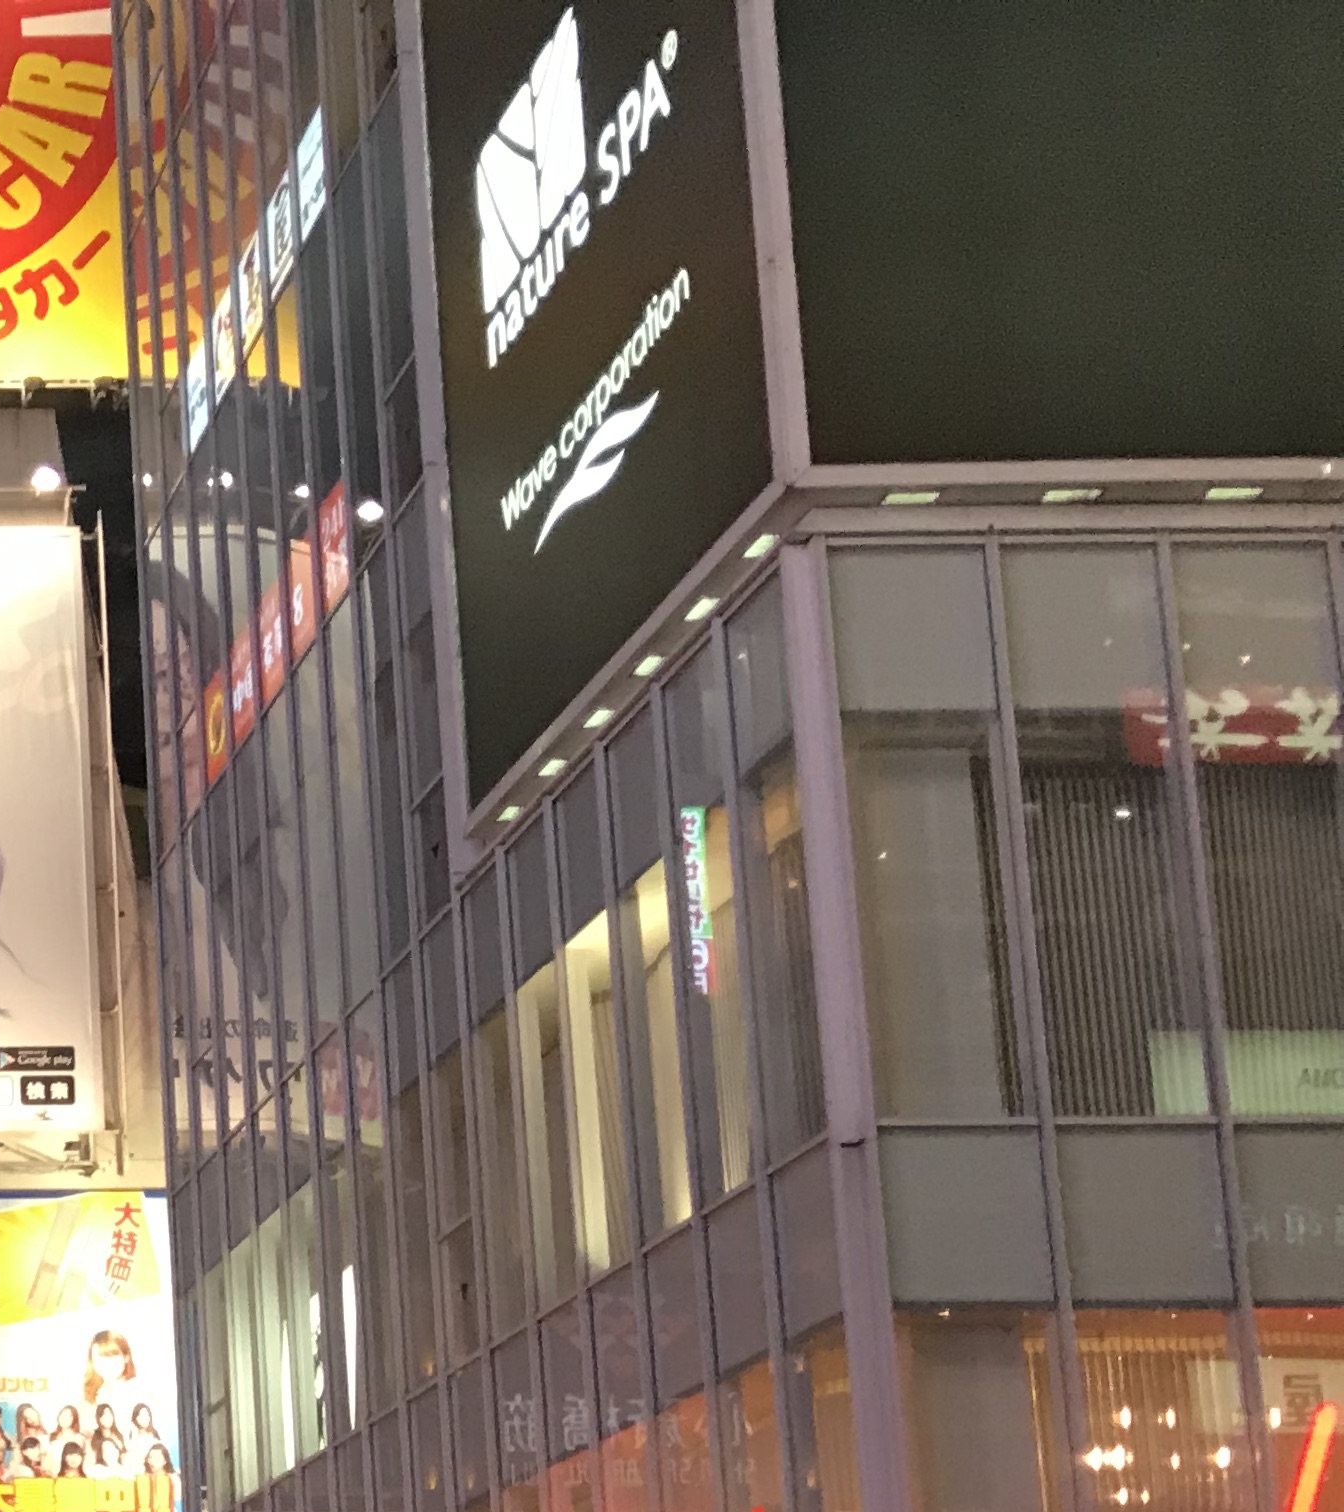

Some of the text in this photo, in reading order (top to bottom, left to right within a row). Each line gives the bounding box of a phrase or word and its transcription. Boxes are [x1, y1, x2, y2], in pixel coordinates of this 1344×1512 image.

[486, 192, 590, 368] nature
[501, 267, 690, 531] Wave corporation
[17, 1054, 74, 1067] Google play
